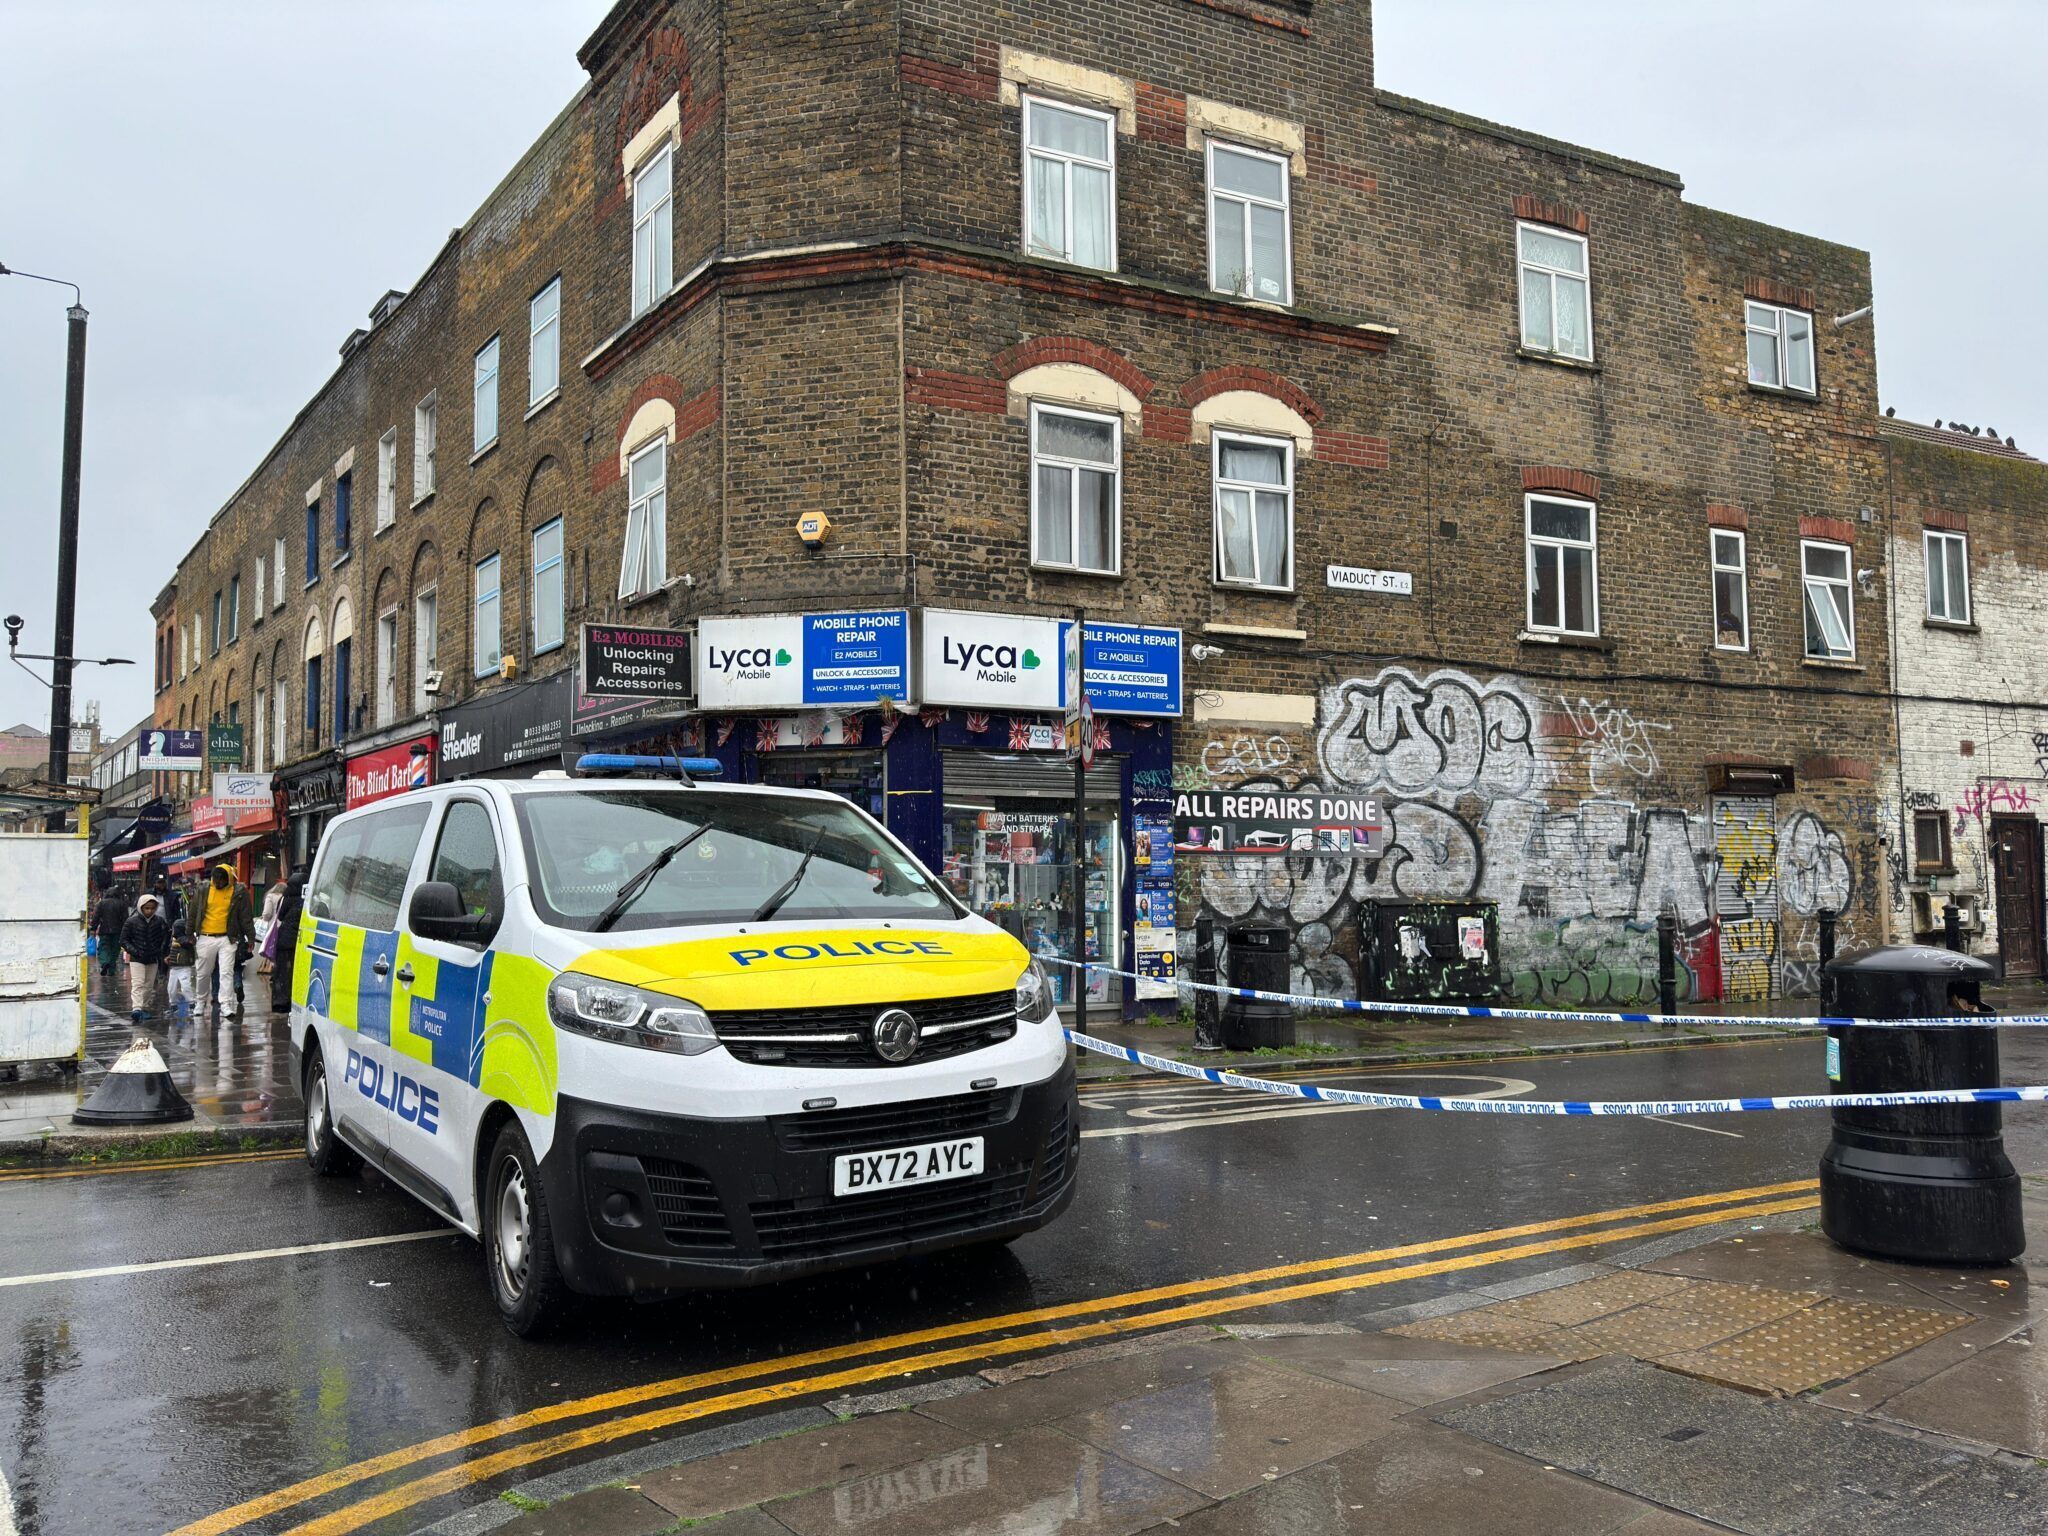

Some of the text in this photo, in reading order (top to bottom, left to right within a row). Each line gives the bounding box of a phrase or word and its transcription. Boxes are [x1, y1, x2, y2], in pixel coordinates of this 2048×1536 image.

[803, 522, 817, 530] ADT
[1332, 570, 1376, 586] VIADUCT
[1382, 576, 1398, 588] ST.
[812, 616, 900, 630] MOBILE PHONE
[592, 630, 684, 648] E2 MOBILES
[836, 631, 876, 643] REPAIR
[1106, 632, 1140, 644] PHONE
[1144, 634, 1176, 647] REPAIR
[604, 646, 674, 664] Unlocking
[710, 646, 770, 672] Lyca
[834, 650, 878, 659] E2 MOBILES
[944, 636, 1016, 671] Lyca
[1098, 652, 1144, 663] E2 MOBILES
[612, 662, 666, 676] Repairs
[736, 670, 770, 680] Mobile
[816, 668, 897, 678] UNLOCK & ACCESSORIES
[976, 670, 1016, 682] Mobile
[596, 676, 682, 690] Accessories
[1084, 671, 1108, 680] NLOCK
[1118, 674, 1164, 684] ACCESSORIES
[1084, 688, 1168, 700] ATCH STRAPS BATTERIES
[529, 726, 540, 736] 0333
[550, 720, 560, 730] 2353
[576, 720, 604, 734] Unlocking
[610, 712, 633, 728] Repairs
[443, 722, 456, 742] mr
[1083, 716, 1092, 749] 20
[212, 737, 240, 748] elms
[442, 732, 482, 762] sneaker
[352, 776, 365, 799] The
[368, 768, 388, 796] Blind
[218, 798, 270, 806] FRESH FISH
[1176, 794, 1376, 821] ALL REPAIRS DONE
[989, 814, 1058, 823] WATCH BATTERIES
[1000, 825, 1048, 833] AND STRAPS
[728, 940, 952, 966] POLICE
[422, 1004, 446, 1022] METROPOLITAN
[424, 1020, 442, 1036] POLICE
[344, 1047, 440, 1136] POLICE
[848, 1142, 973, 1188] BX72 AYC
